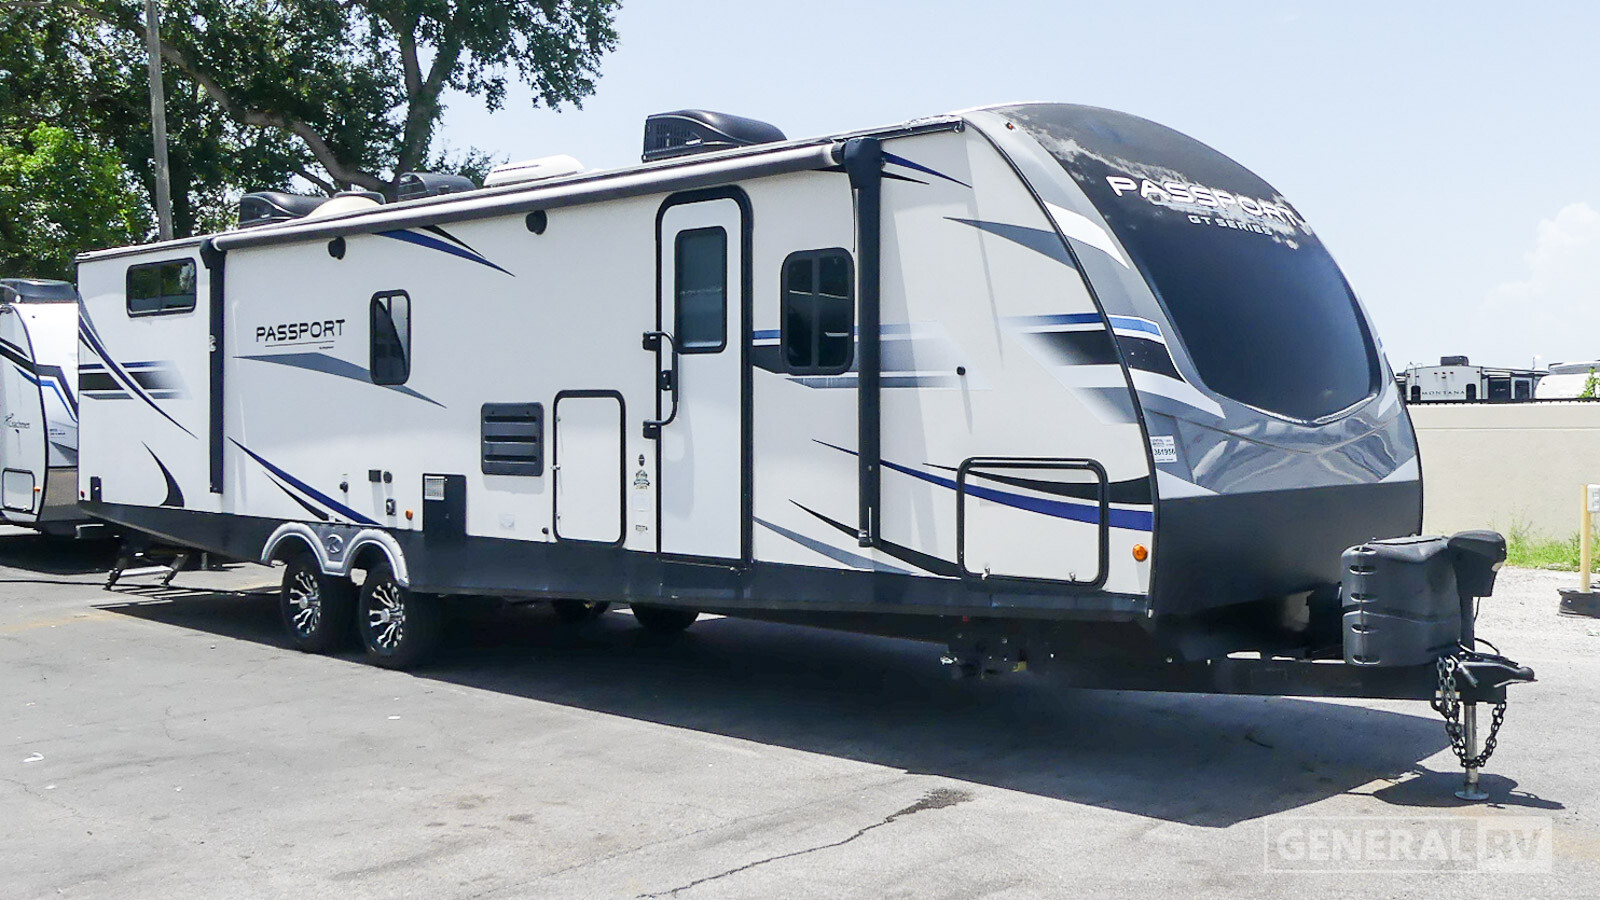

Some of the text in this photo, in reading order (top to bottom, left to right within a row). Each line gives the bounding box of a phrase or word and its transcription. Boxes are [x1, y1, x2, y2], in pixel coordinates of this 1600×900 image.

[1106, 175, 1302, 227] PASSPORT
[1187, 214, 1273, 236] GT SERIES
[256, 319, 345, 343] PASSPORT
